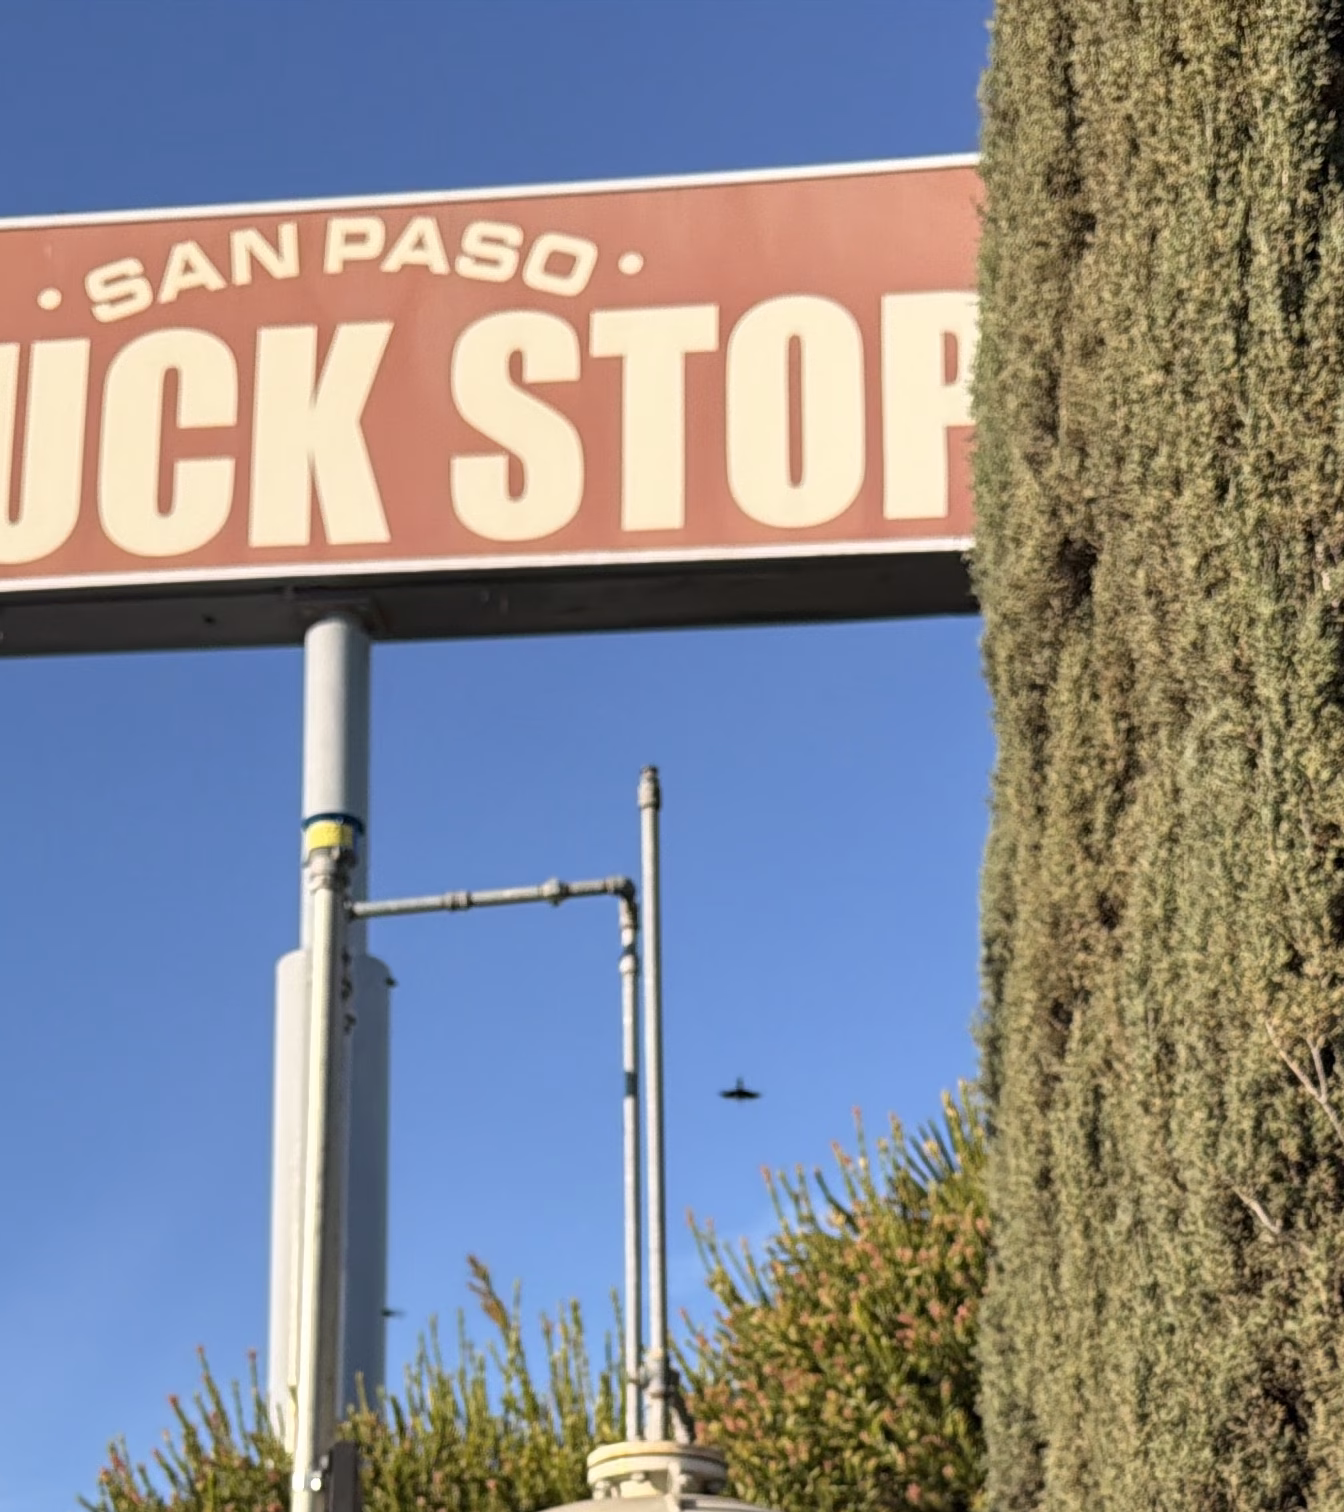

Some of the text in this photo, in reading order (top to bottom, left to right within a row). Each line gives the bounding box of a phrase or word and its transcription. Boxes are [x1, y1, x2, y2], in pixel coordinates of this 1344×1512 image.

[83, 215, 599, 323] SAN PASO
[450, 290, 981, 542] STOP
